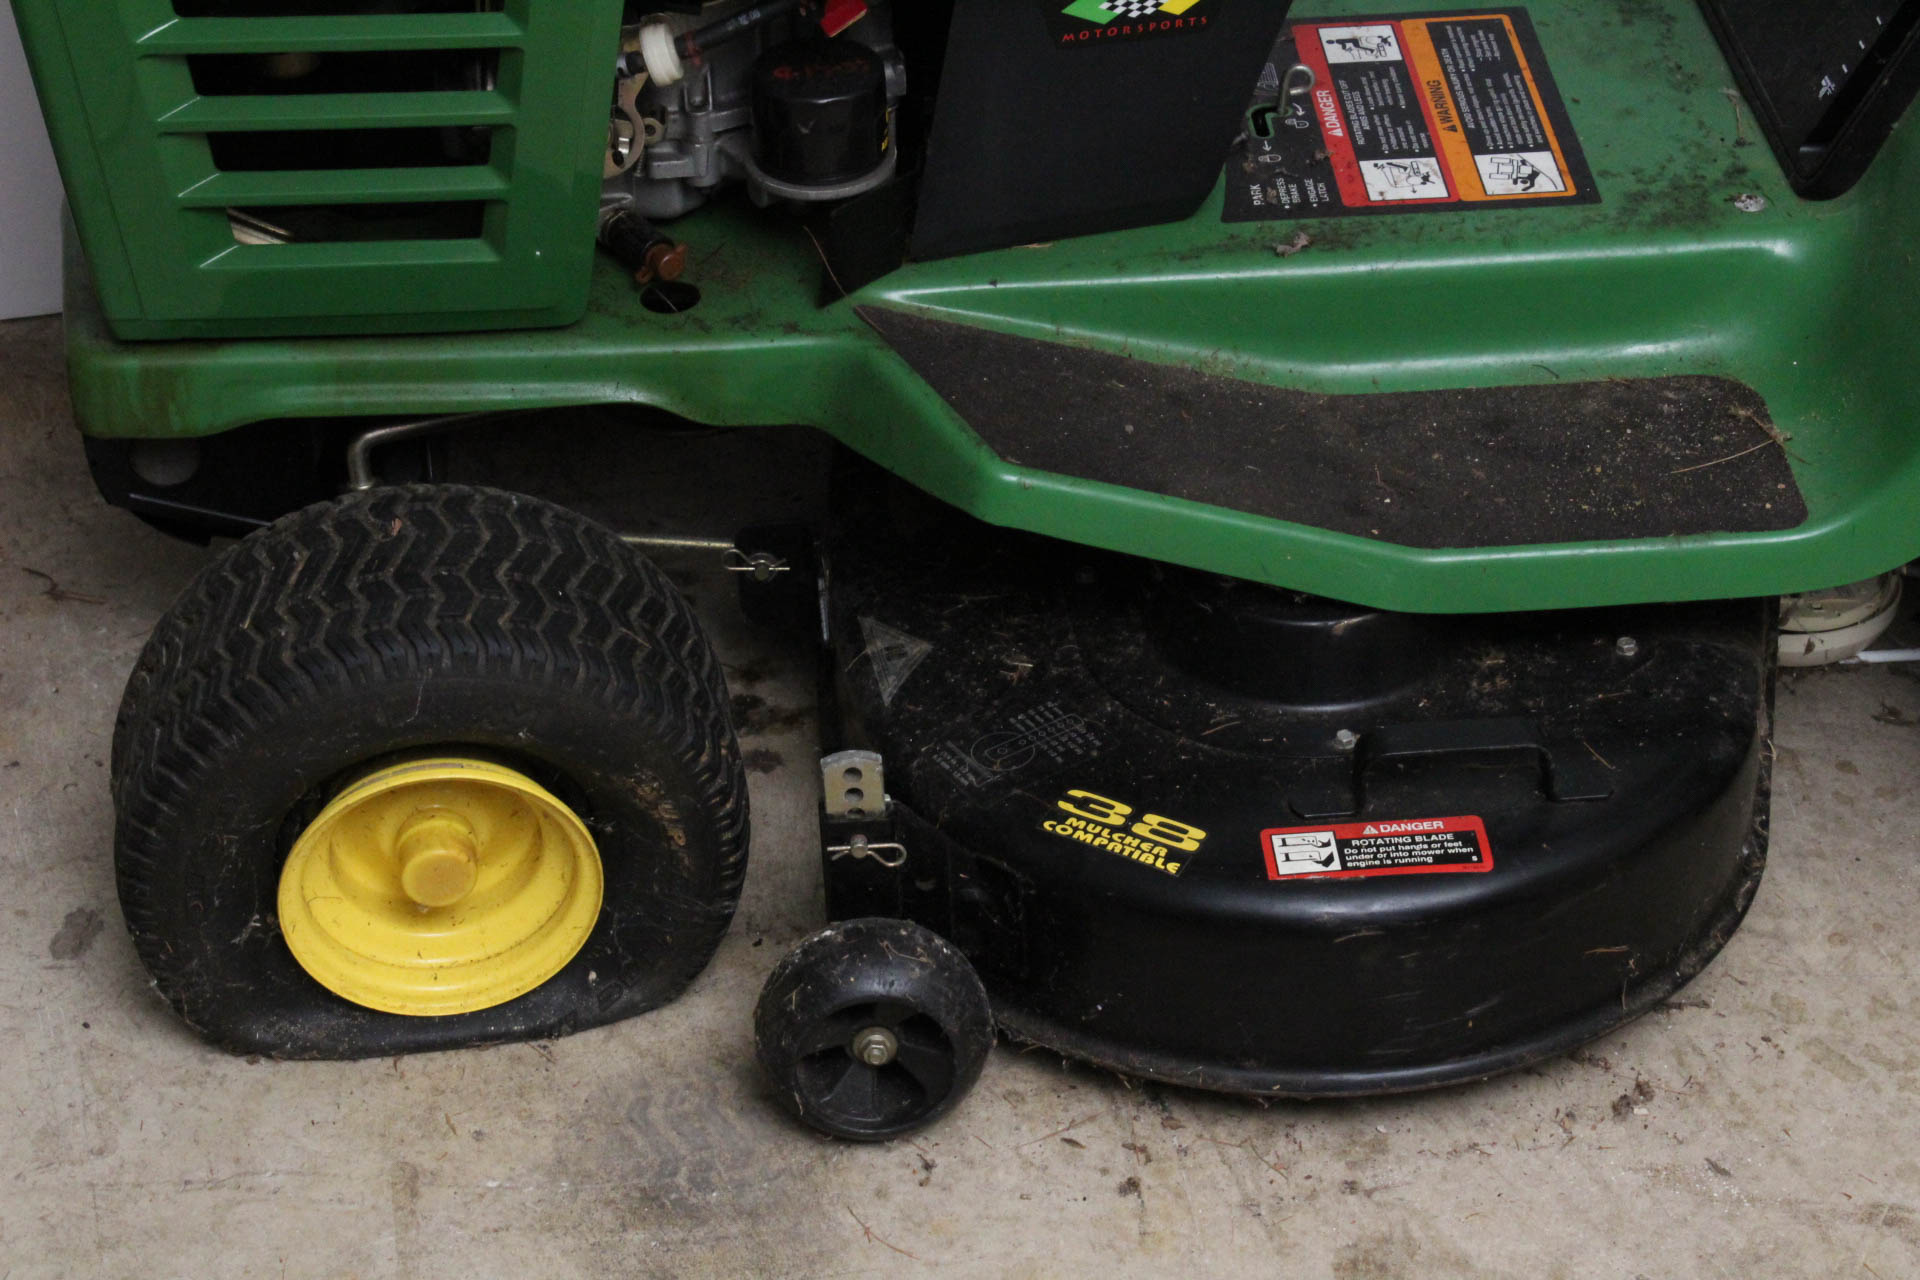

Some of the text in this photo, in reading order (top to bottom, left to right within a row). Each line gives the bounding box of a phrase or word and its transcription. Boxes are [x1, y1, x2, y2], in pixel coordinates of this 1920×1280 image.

[1062, 16, 1208, 42] MOTORSPORTS
[1440, 48, 1452, 64] DEATH
[1449, 73, 1462, 90] INJURY
[1316, 90, 1340, 128] DANGER
[1338, 79, 1365, 144] ROTATING BLADES CUT OFF
[1351, 91, 1370, 129] ARMS AND LEGS
[1427, 80, 1453, 124] WARNING
[1455, 90, 1469, 112] SERIOUS
[1463, 112, 1475, 128] AVOID
[1250, 183, 1264, 206] PARK
[1288, 183, 1300, 203] BRAKE
[1304, 178, 1318, 202] ENGAGE
[1058, 789, 1206, 852] 38
[1380, 821, 1444, 833] DANGER
[1043, 820, 1181, 874] COMPATIBLE
[1065, 817, 1168, 857] MULCHER
[1352, 833, 1454, 847] ROTATING BLADE
[1380, 845, 1396, 853] put
[1398, 843, 1428, 851] hands
[1345, 853, 1374, 861] under
[1448, 846, 1474, 854] when
[1347, 860, 1380, 868] engine
[1394, 856, 1433, 864] running
